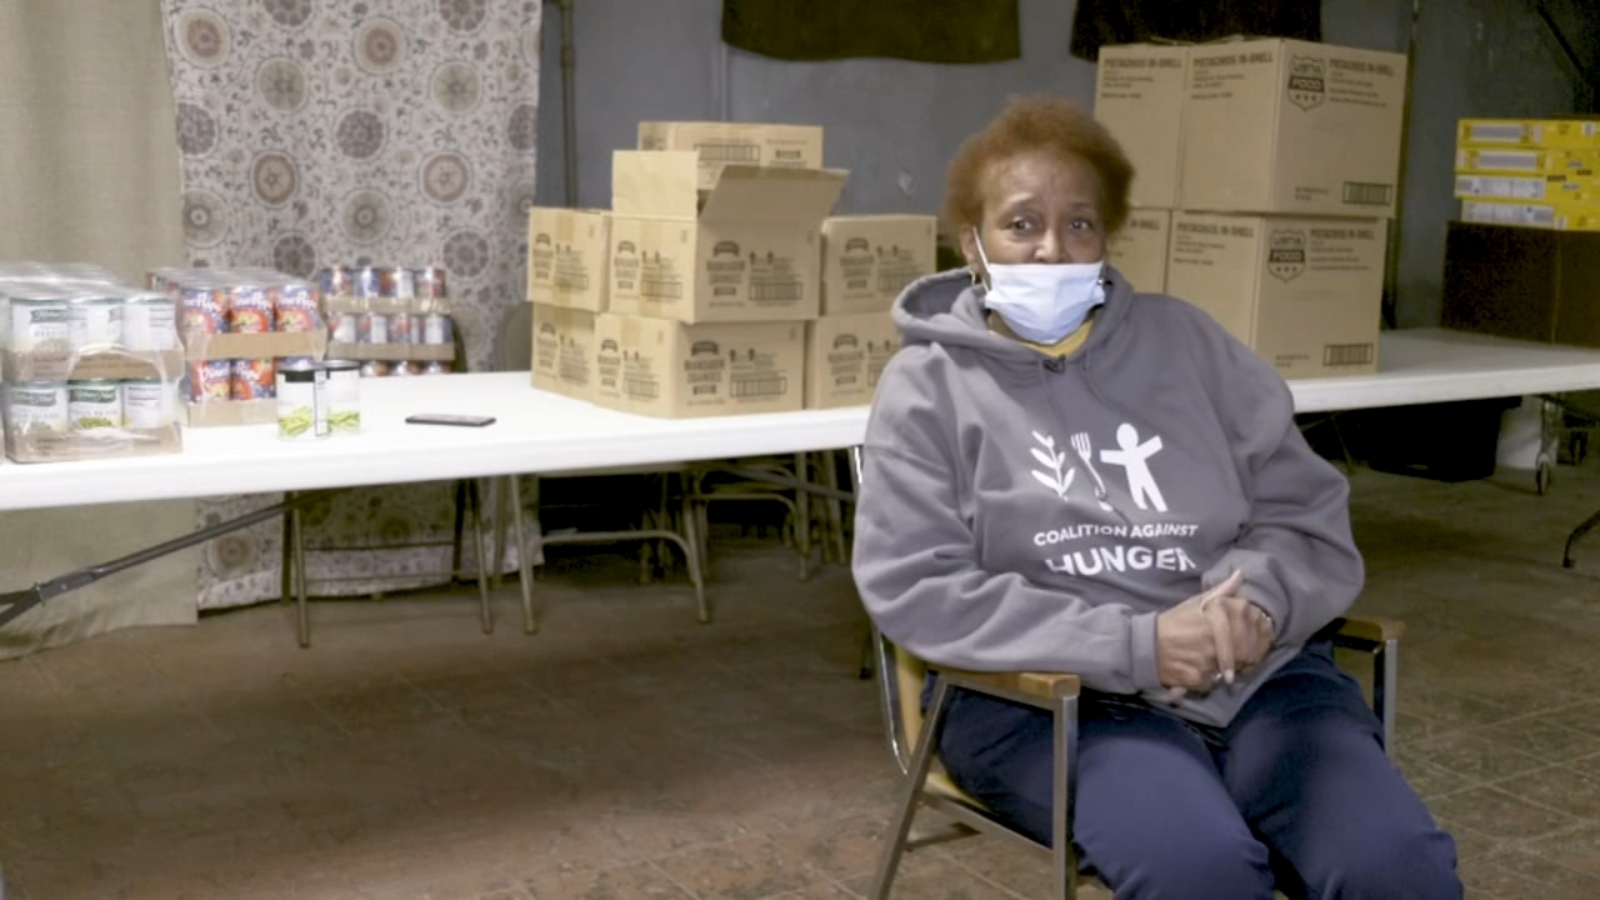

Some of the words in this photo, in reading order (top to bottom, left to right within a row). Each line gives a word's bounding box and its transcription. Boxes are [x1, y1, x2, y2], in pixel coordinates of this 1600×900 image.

[1293, 78, 1321, 91] FOOD
[1273, 251, 1302, 262] FOOD
[1033, 524, 1127, 546] COALITION
[1130, 523, 1198, 539] AGAINST
[1046, 545, 1196, 576] HUNGER
